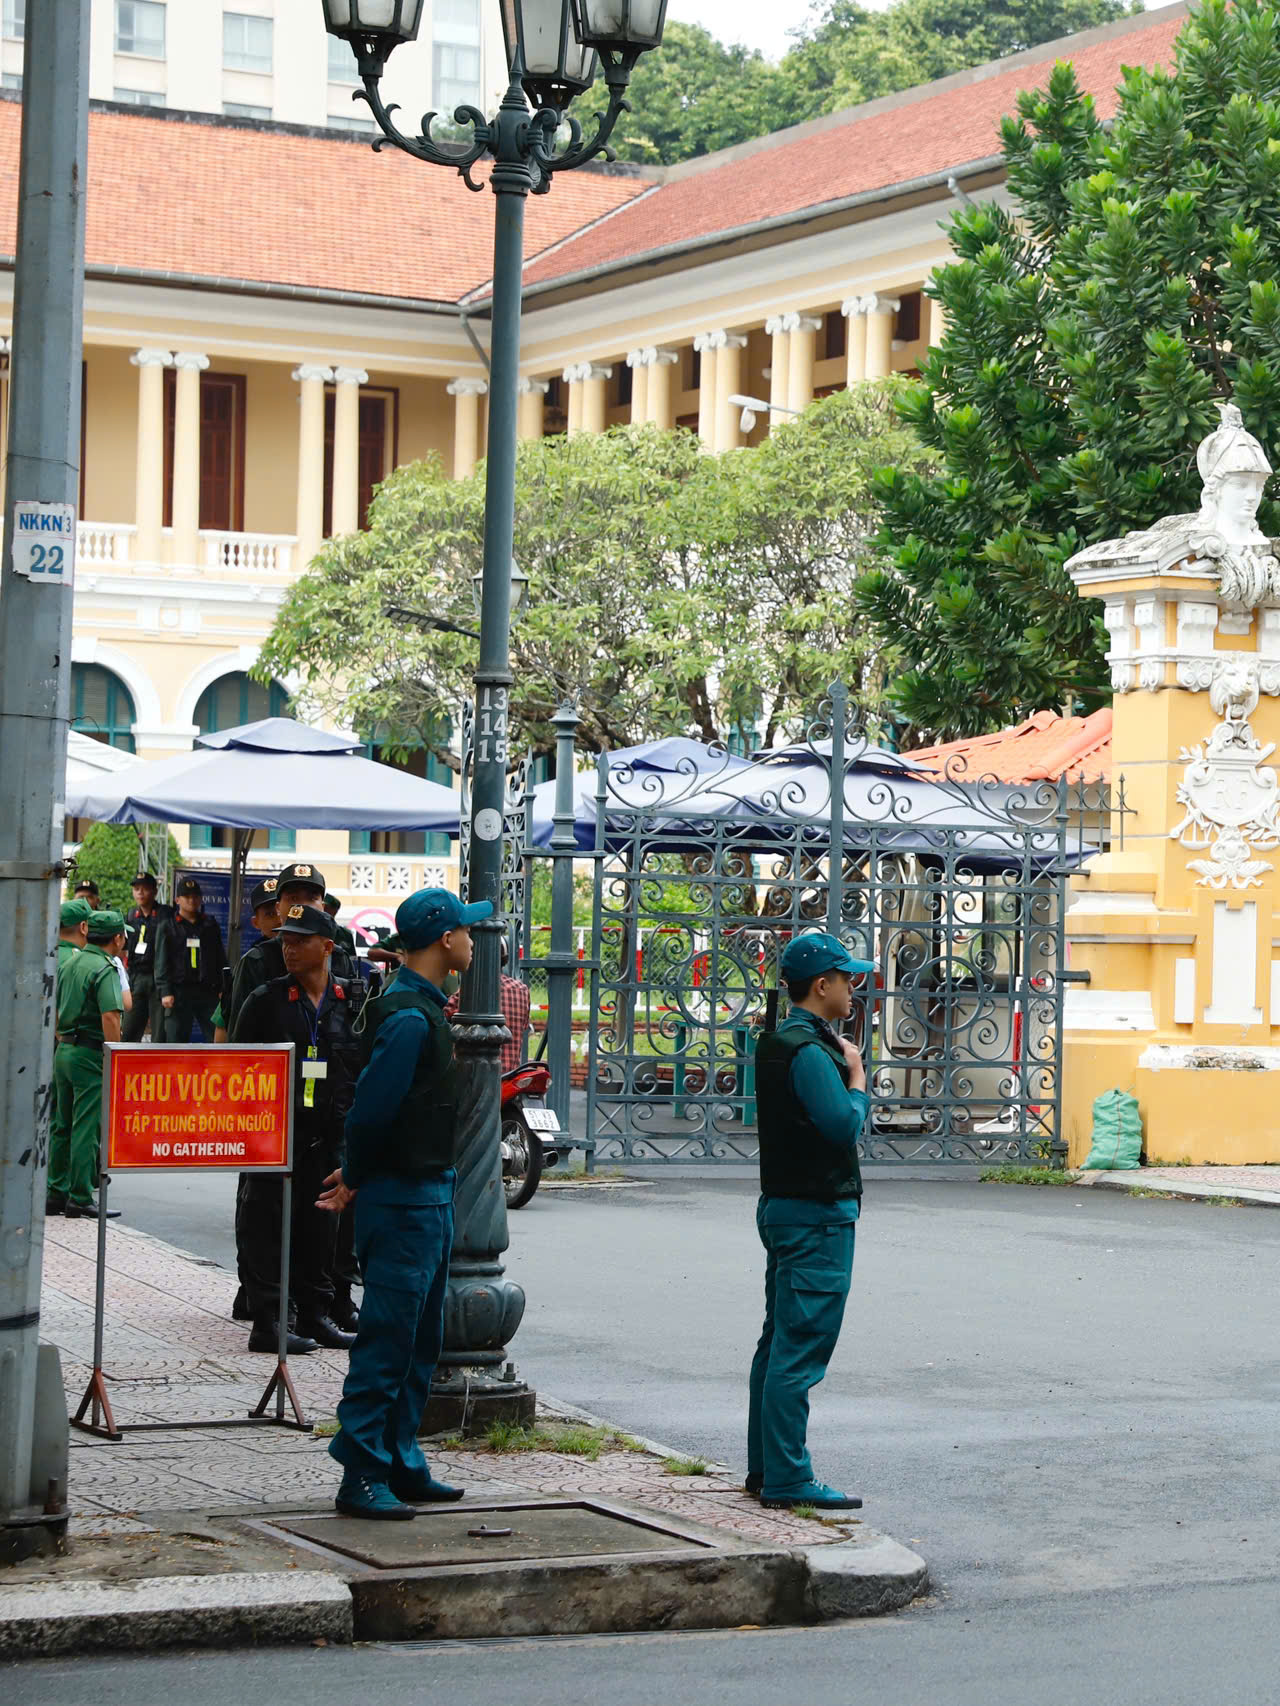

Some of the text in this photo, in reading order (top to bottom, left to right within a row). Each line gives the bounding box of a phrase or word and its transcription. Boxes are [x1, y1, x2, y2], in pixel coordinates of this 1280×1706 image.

[19, 513, 63, 532] NKKN
[30, 543, 64, 575] 22
[480, 686, 507, 711] 13
[480, 712, 507, 737] 14
[478, 739, 506, 764] 15
[124, 1063, 277, 1107] KHU VỰC CẤM
[124, 1111, 275, 1136] TẬP TRUNG ĐÔNG NGƯỜI
[152, 1142, 246, 1157] NO GATHERING
